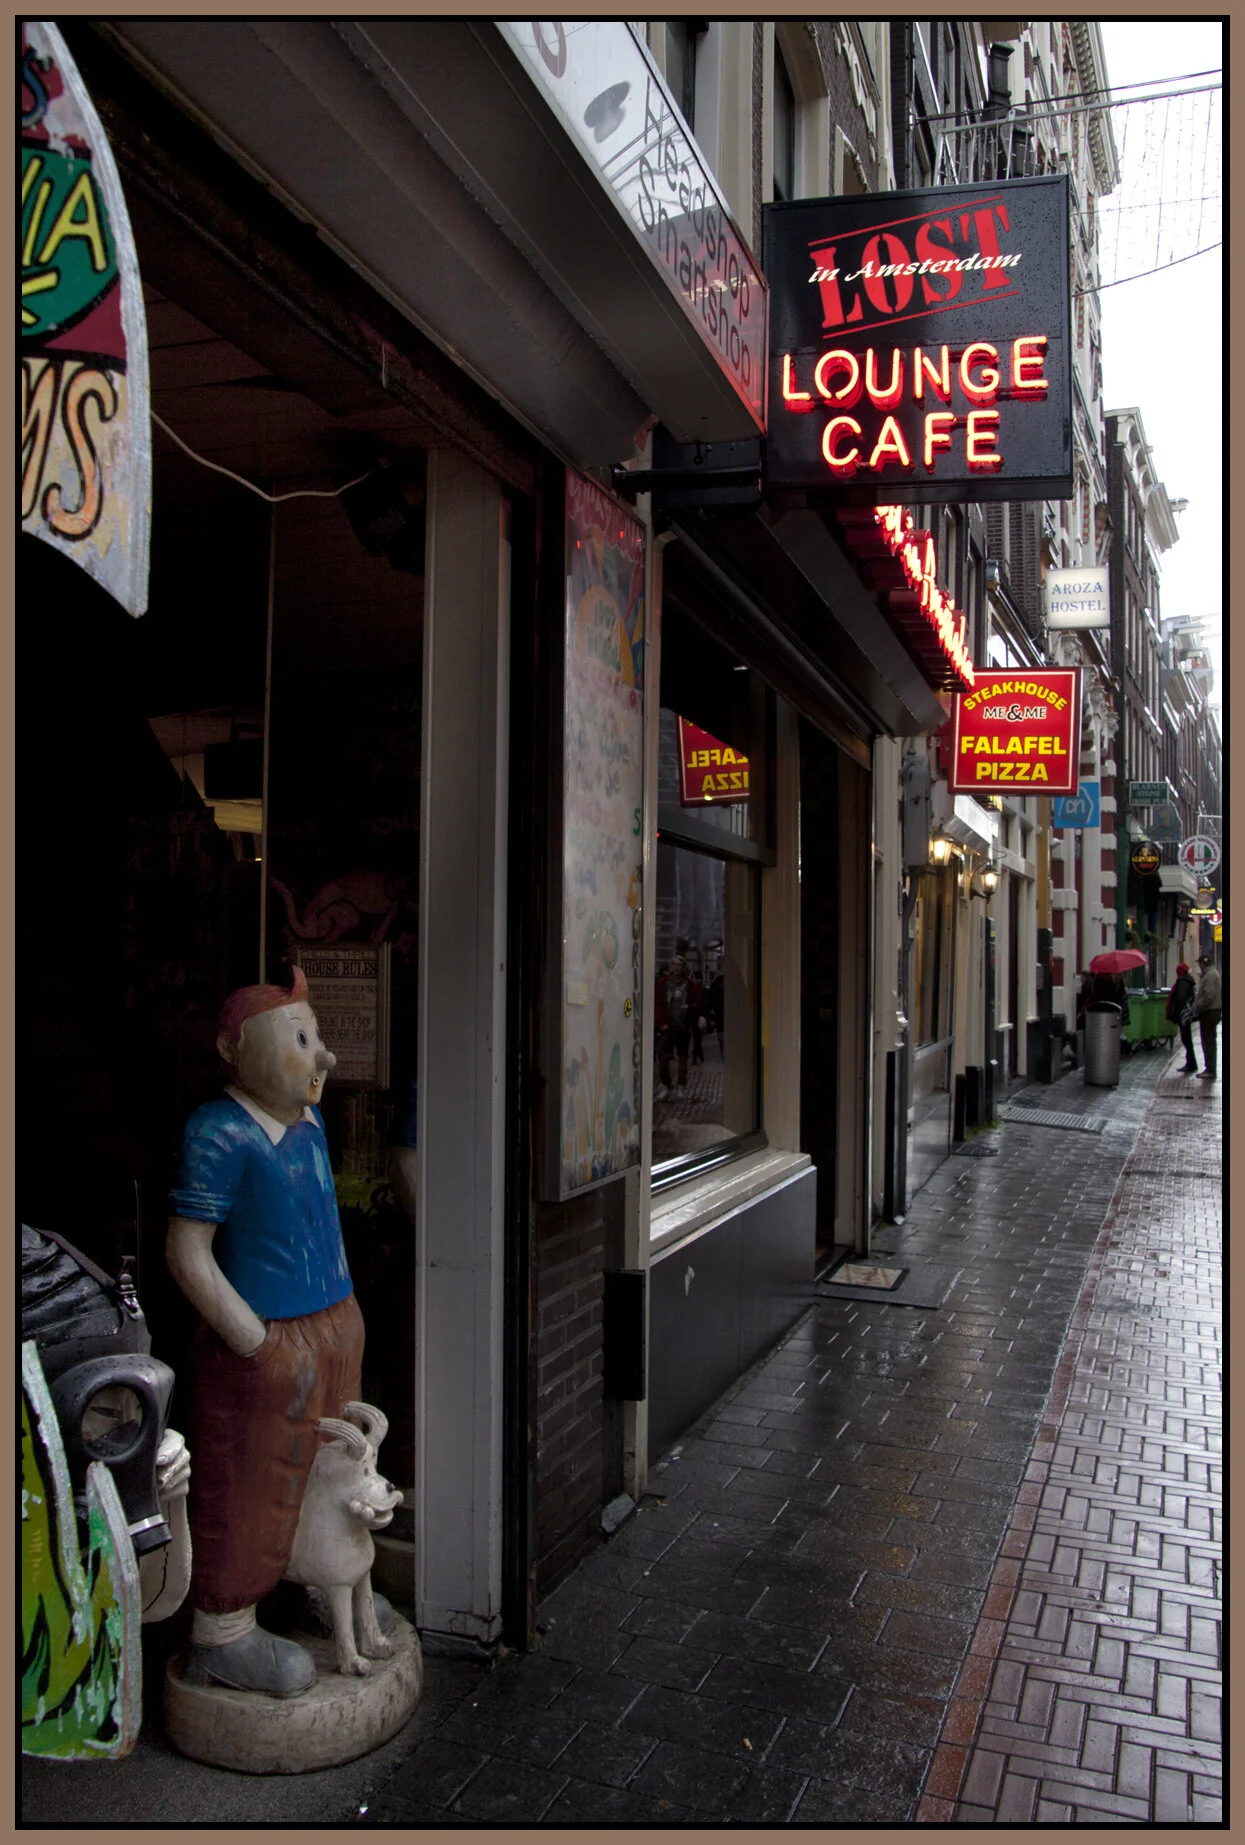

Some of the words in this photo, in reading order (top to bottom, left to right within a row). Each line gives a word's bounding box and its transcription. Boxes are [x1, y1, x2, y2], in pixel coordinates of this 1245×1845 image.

[643, 75, 750, 328] Headshop
[638, 154, 751, 388] Smartshop
[808, 266, 837, 283] in
[845, 253, 1022, 282] Amsterdam
[809, 204, 1012, 329] LOST
[782, 336, 1050, 402] LOUNGE
[821, 410, 1002, 467] CAFE
[1051, 582, 1104, 595] AROZA
[1050, 598, 1106, 613] HOSTEL
[963, 681, 1068, 711] STEAKHOUSE
[960, 735, 1067, 756] FALAFEL
[975, 762, 1049, 781] PIZZA
[304, 961, 339, 975] HOUSE
[343, 961, 377, 975] RULES
